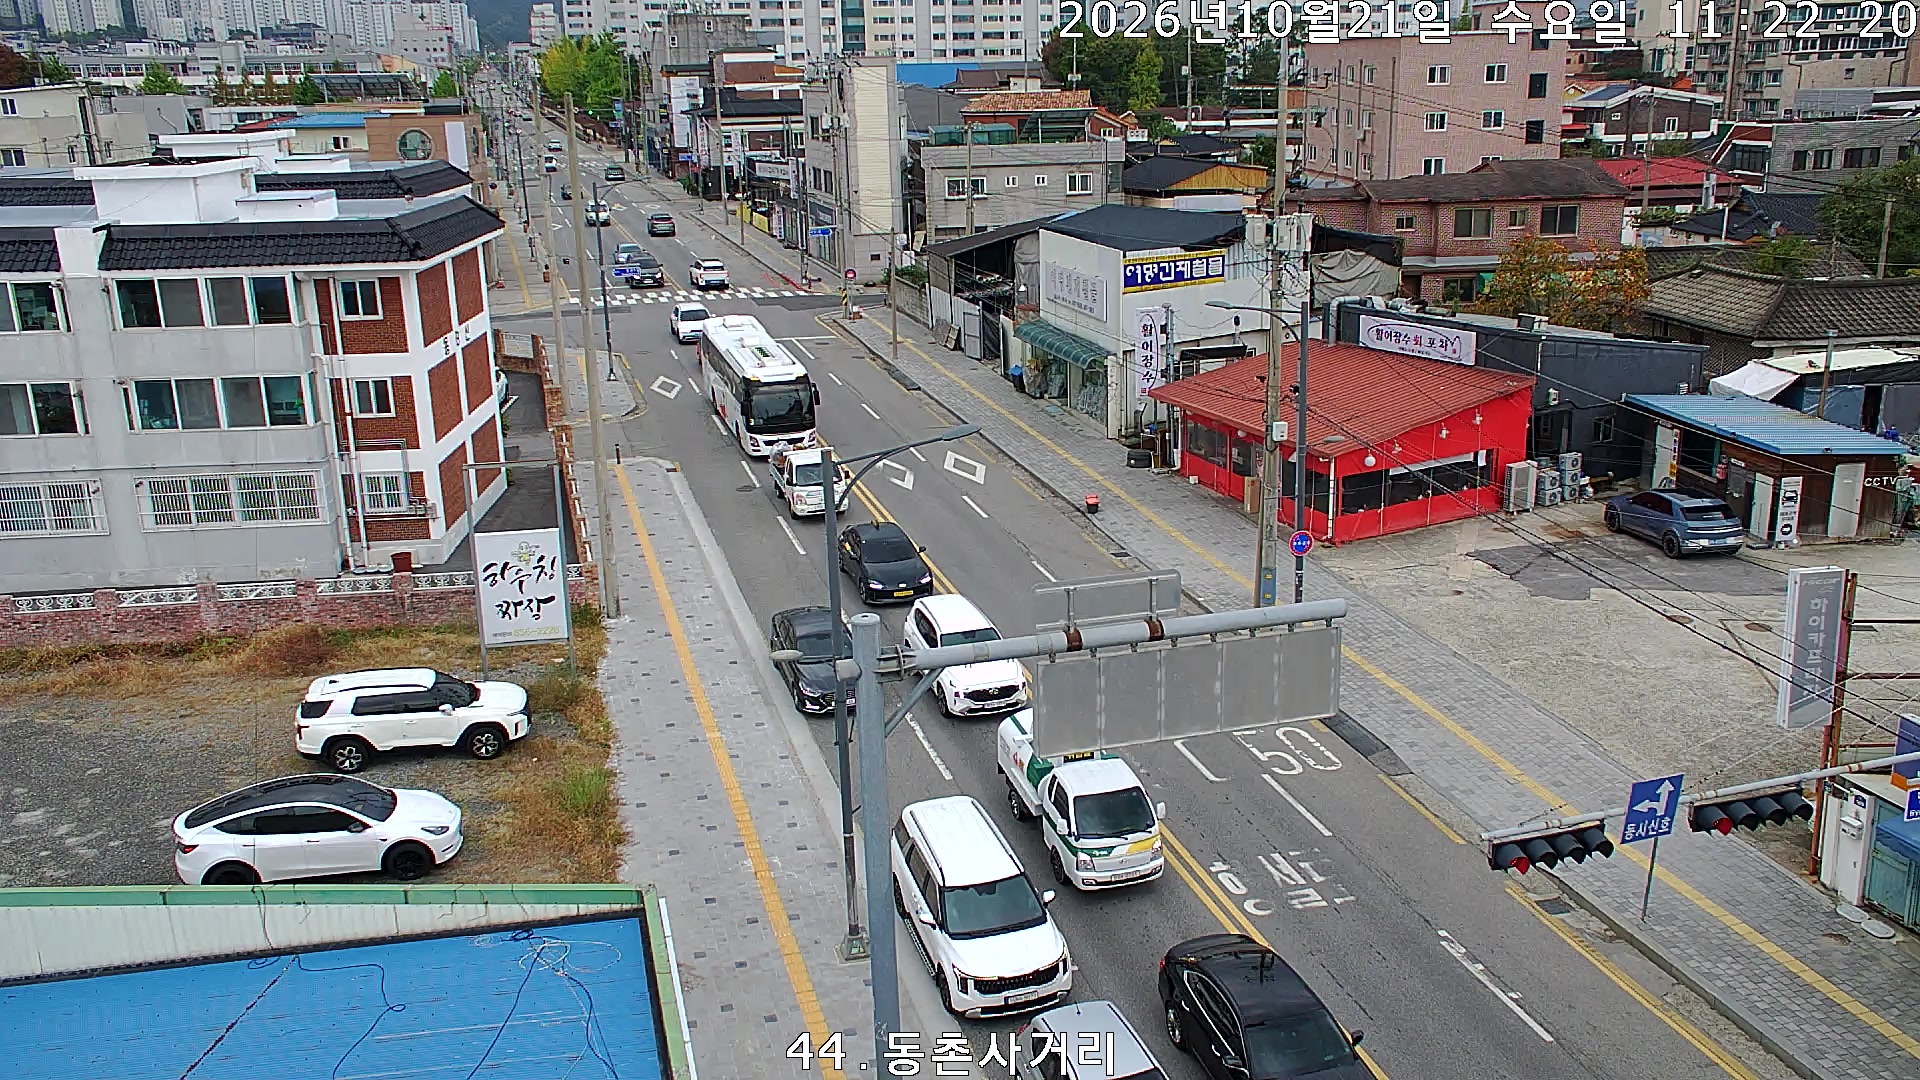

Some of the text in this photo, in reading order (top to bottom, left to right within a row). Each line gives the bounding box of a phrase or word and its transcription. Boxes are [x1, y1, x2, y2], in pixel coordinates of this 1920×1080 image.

[1864, 476, 1896, 487] CCTV
[494, 595, 557, 621] 짜장
[1231, 726, 1343, 776] 50
[1624, 816, 1672, 841] 동시신호
